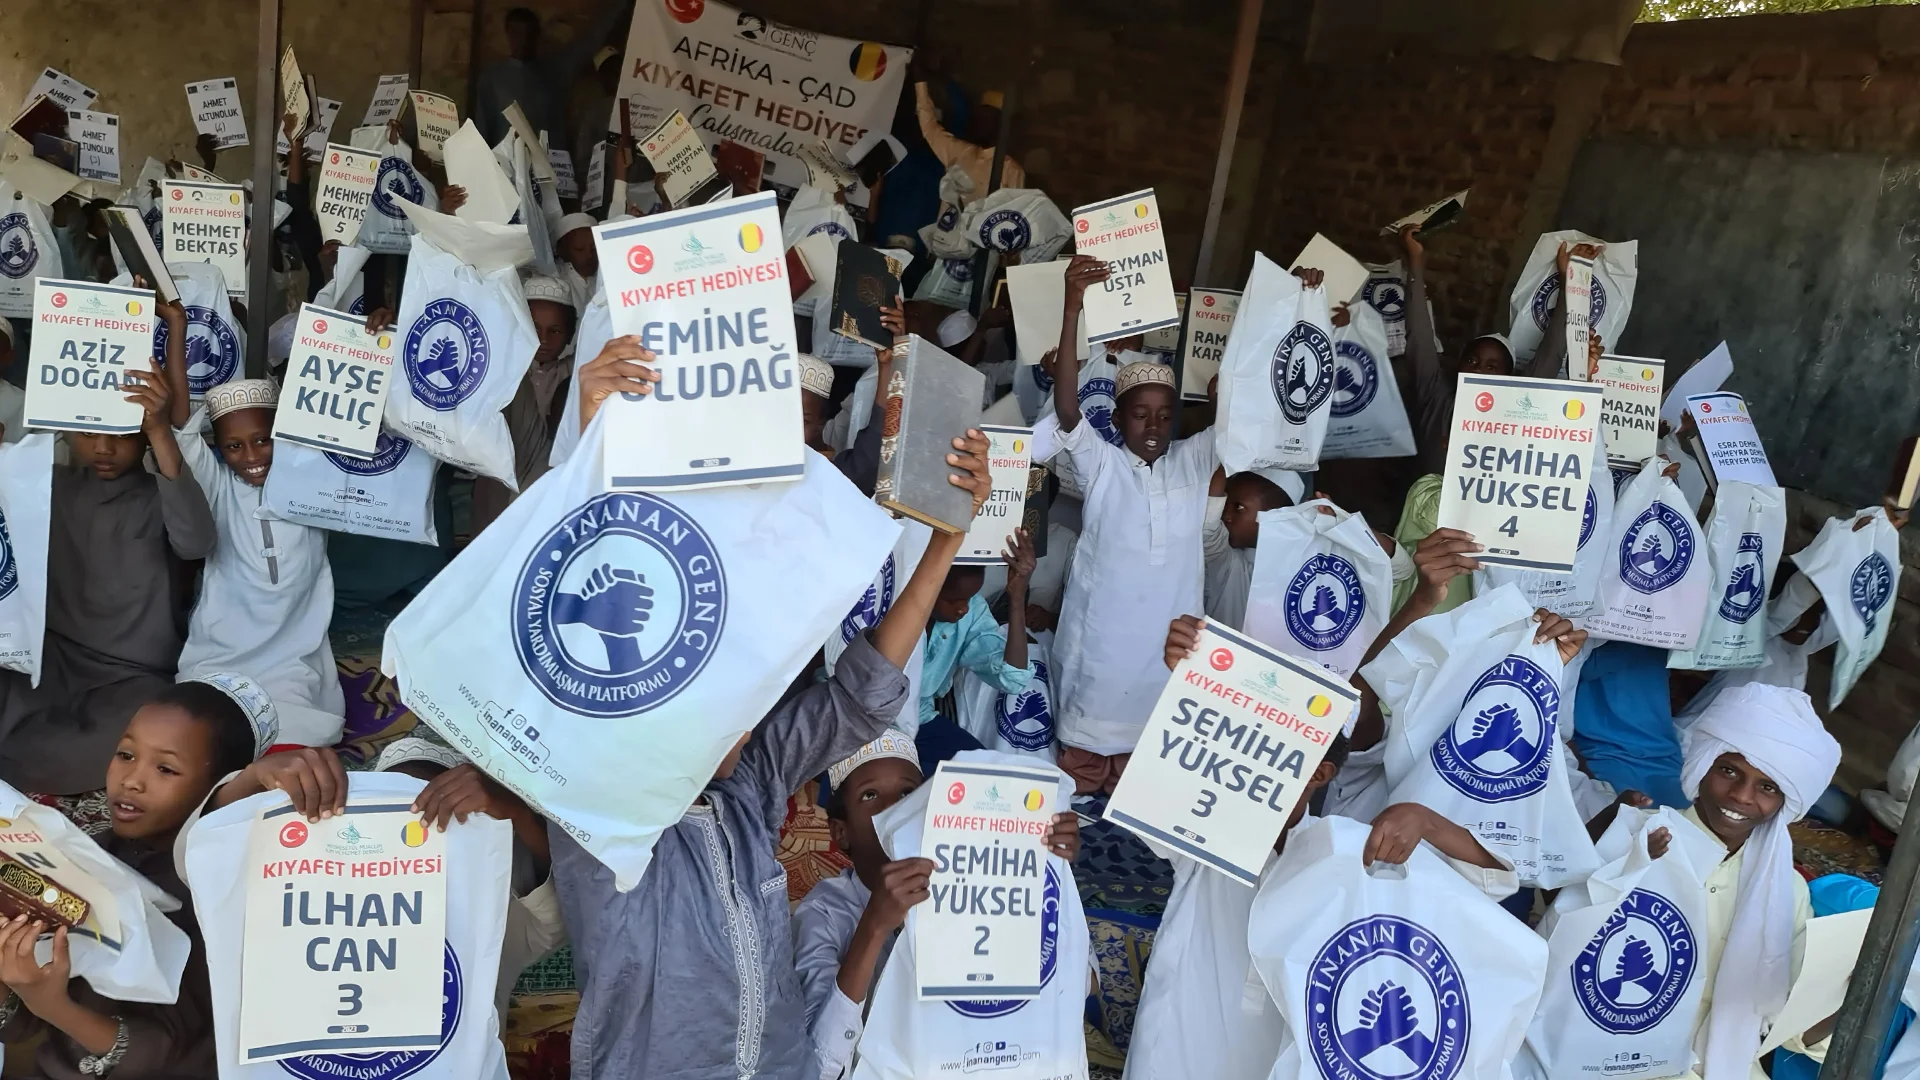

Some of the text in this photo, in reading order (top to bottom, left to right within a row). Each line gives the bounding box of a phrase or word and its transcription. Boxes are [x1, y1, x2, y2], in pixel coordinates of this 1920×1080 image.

[770, 29, 818, 56] GENÇ
[673, 36, 773, 86] AFRİKA
[798, 76, 856, 109] ÇAD
[49, 88, 77, 105] AHMET
[203, 97, 227, 109] AHMET
[632, 58, 870, 147] KIYAFET HEDİYES
[198, 108, 239, 122] ALTUNOLUK
[82, 129, 107, 141] AHMET
[426, 122, 451, 137] HARUN
[80, 142, 115, 156] LTUNOLUK
[666, 145, 692, 168] HARUN
[667, 146, 704, 179] AYKAPTAN
[681, 165, 692, 176] 10
[324, 169, 376, 186] KIYAFET HEDİYESİ
[322, 184, 371, 206] MEHMET
[169, 206, 244, 219] KIYAFET HEDİYESİ
[320, 201, 366, 225] BEKTAŞ
[172, 221, 241, 239] MEHMET
[335, 221, 347, 234] 5
[1114, 218, 1159, 239] HEDİYESİ
[175, 238, 238, 258] BEKTAŞ
[1106, 249, 1164, 275] EYMAN
[621, 279, 697, 308] KIYAFET
[701, 257, 783, 293] HEDİYESİ
[1103, 272, 1146, 293] USTA
[1590, 283, 1604, 306] ENÇ
[1123, 293, 1133, 307] 2
[41, 313, 151, 334] KIYAFET HEDİYESİ
[1195, 310, 1231, 323] KIYAFET
[463, 315, 486, 363] GENÇ
[642, 307, 770, 357] EMİNE
[59, 338, 126, 366] AZİZ
[301, 336, 394, 366] KIYAFET HEDİYESİ
[1310, 332, 1333, 373] GENÇ
[299, 355, 385, 395] AYŞE
[1618, 380, 1660, 394] HEDİYESİ
[295, 386, 376, 430] KILIÇ
[1602, 398, 1656, 418] MAZAN
[1700, 415, 1731, 425] KIYAFET
[1461, 419, 1593, 443] KIYAFET HEDİYESİ
[1601, 413, 1656, 432] RAMAN
[1613, 429, 1619, 441] 1
[1711, 449, 1750, 459] HÜMEYRA
[1717, 441, 1738, 450] ESRA
[992, 458, 1029, 469] HEDİYESİ
[1461, 444, 1582, 480] SEMİHA
[1718, 457, 1751, 467] MERYEM
[990, 487, 1023, 503] ETTİN
[1458, 472, 1577, 512] YÜKSEL
[977, 503, 1007, 518] OYLÜ
[1498, 515, 1519, 538] 4
[1663, 512, 1691, 548] GENÇ
[563, 499, 717, 651] İNANAN GENÇ
[1332, 561, 1361, 596] GENÇ
[1652, 558, 1685, 587] PLATFORMU
[527, 567, 672, 702] SOSYAL YARDIMLAŞMA PLATFORMU
[1185, 669, 1254, 709] KIYAFET
[1253, 699, 1332, 747] HEDİYESİ
[1171, 697, 1306, 780] SEMİHA
[412, 688, 430, 705] +90
[428, 704, 446, 723] 212
[444, 718, 462, 738] 925
[460, 734, 474, 749] 20
[470, 746, 483, 760] 27
[563, 822, 577, 834] 50
[577, 830, 592, 843] 20
[1159, 730, 1284, 813] YÜKSEL
[1437, 737, 1454, 771] SOSYAL
[1454, 764, 1515, 794] YARDIMLAŞMA
[1190, 788, 1218, 819] 3
[933, 814, 987, 832] KIYAFET
[263, 854, 442, 880] KIYAFET HEDİYESİ
[934, 839, 1038, 878] SEMİHA
[1553, 854, 1565, 862] 20
[282, 882, 424, 928] İLHAN
[931, 878, 1036, 917] YÜKSEL
[1650, 901, 1690, 952] GENÇ
[974, 926, 991, 956] 2
[305, 936, 398, 973] CAN
[1312, 924, 1460, 1008] İNANAN GENÇ
[337, 983, 364, 1017] 3
[1582, 970, 1683, 1026] SOSYAL YARDILAŞMA PLATFORMU
[341, 1025, 358, 1033] 2023
[1316, 1022, 1340, 1069] SOSYAL
